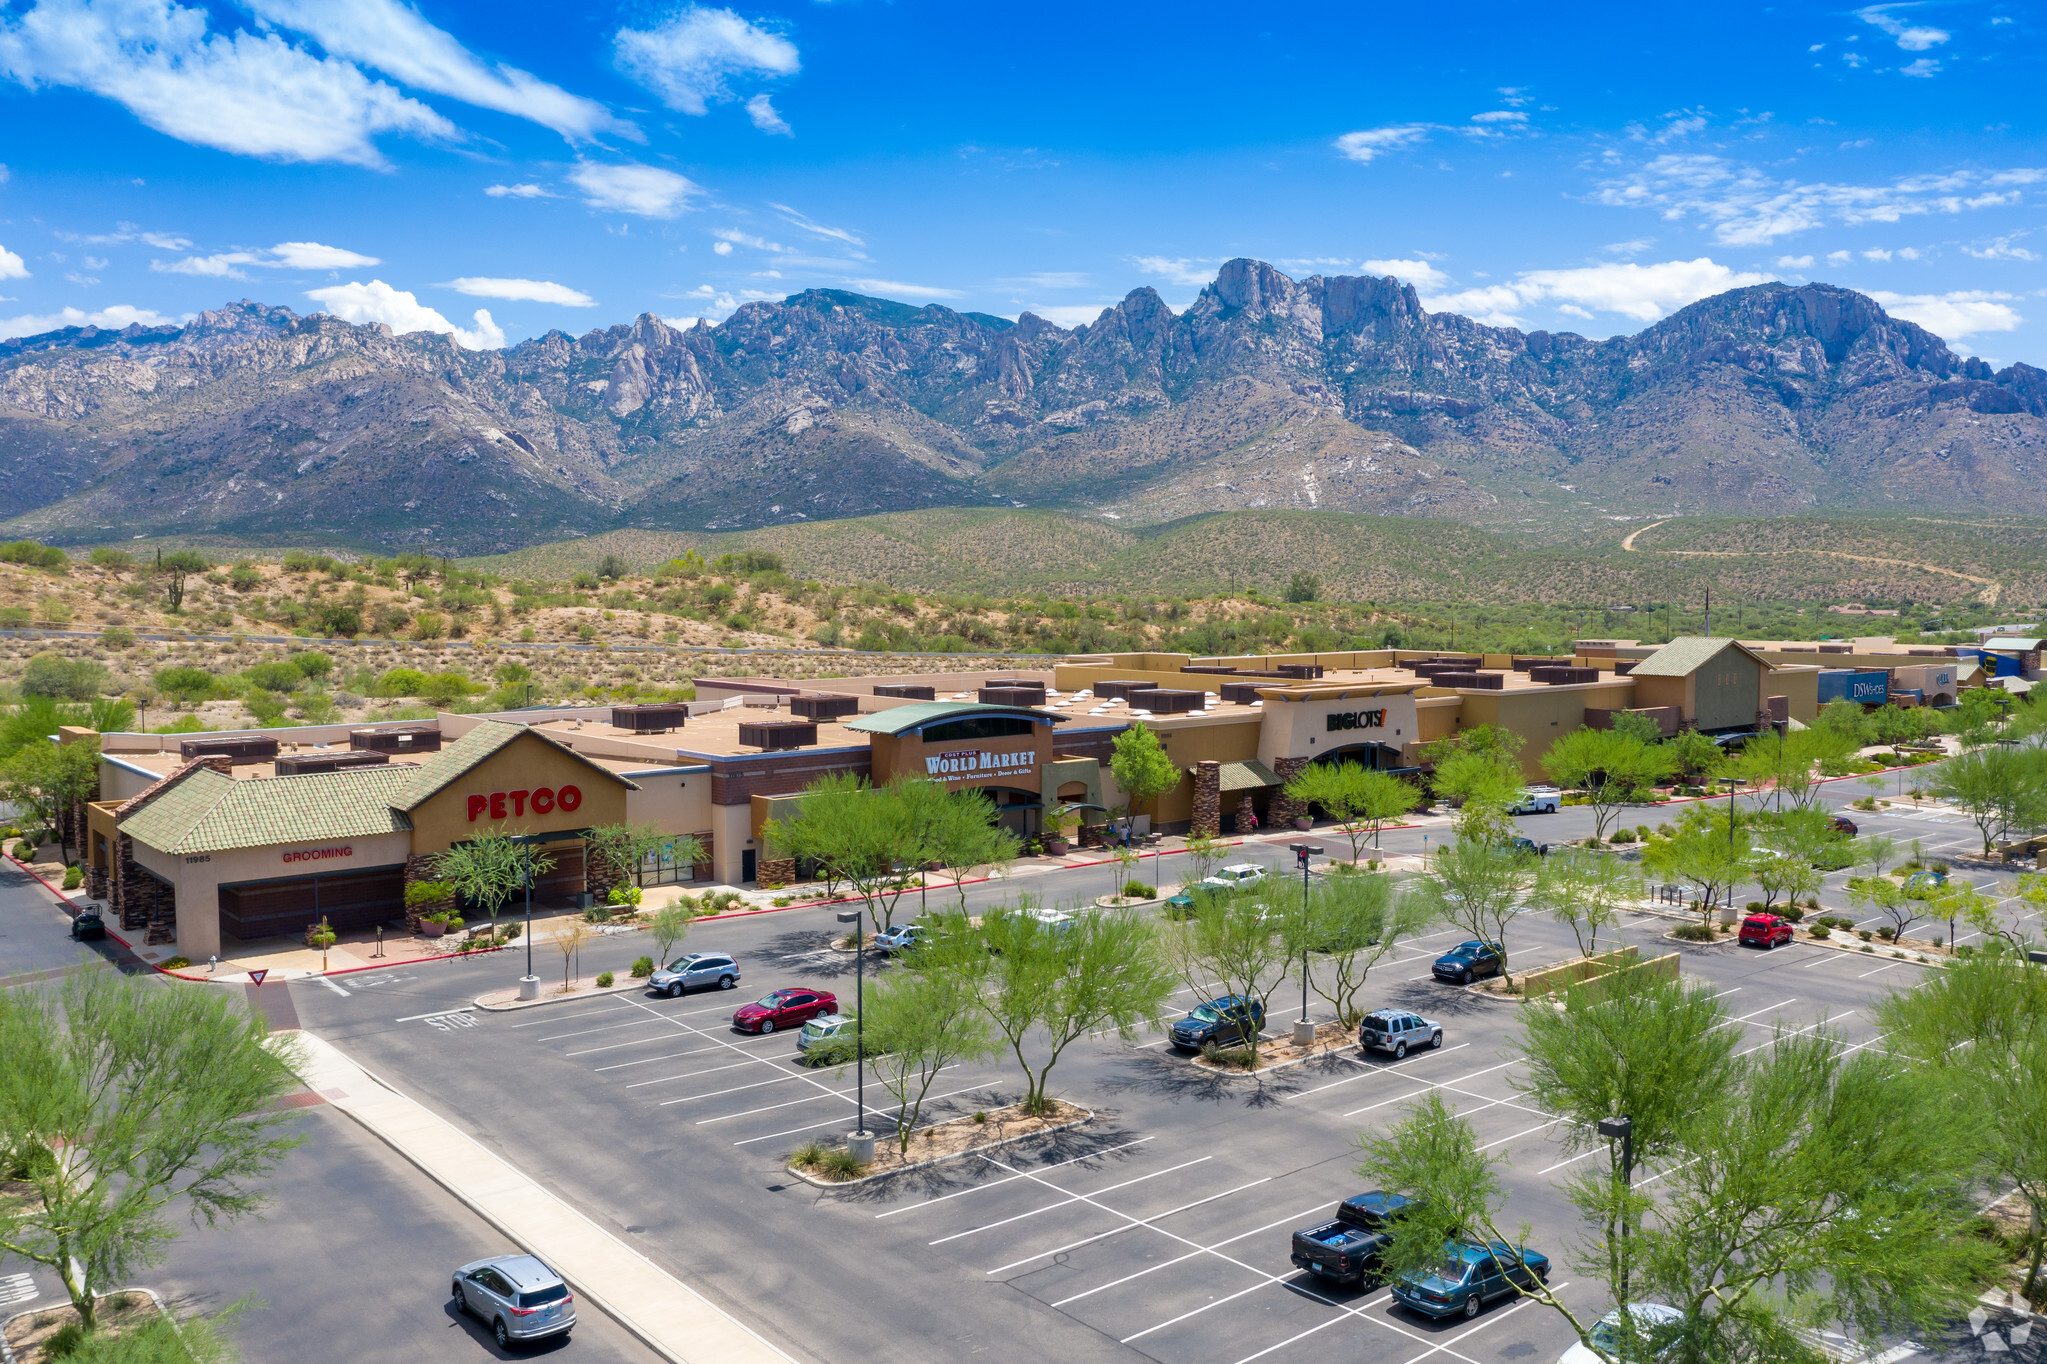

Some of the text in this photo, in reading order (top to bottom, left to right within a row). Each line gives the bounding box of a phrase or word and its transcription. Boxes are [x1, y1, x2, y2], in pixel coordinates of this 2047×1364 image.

[925, 751, 1035, 774] WORLD MARKET
[966, 772, 993, 780] Furniture
[467, 785, 582, 822] PETCO
[185, 855, 211, 864] 11985
[282, 847, 353, 863] GROOMING
[424, 1013, 480, 1032] STOP
